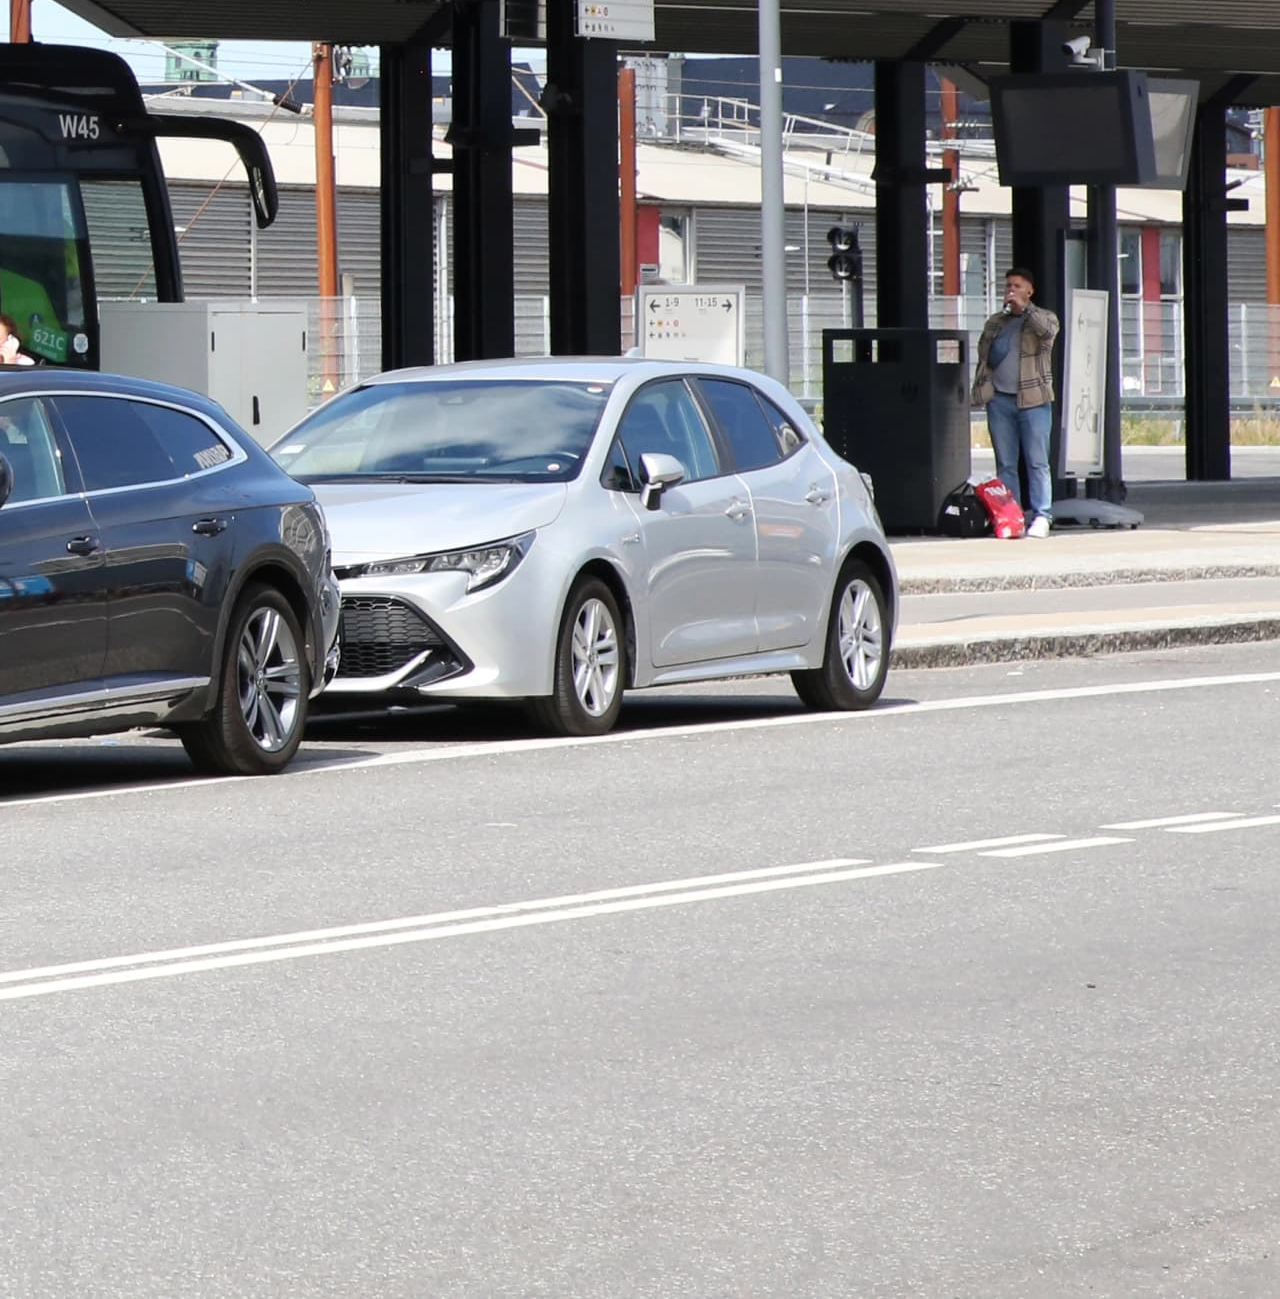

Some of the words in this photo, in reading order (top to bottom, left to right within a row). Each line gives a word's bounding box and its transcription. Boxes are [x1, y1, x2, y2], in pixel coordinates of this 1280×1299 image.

[59, 114, 100, 139] W45
[665, 297, 680, 307] 1-9
[695, 297, 718, 307] 11-15
[33, 328, 65, 351] 621C
